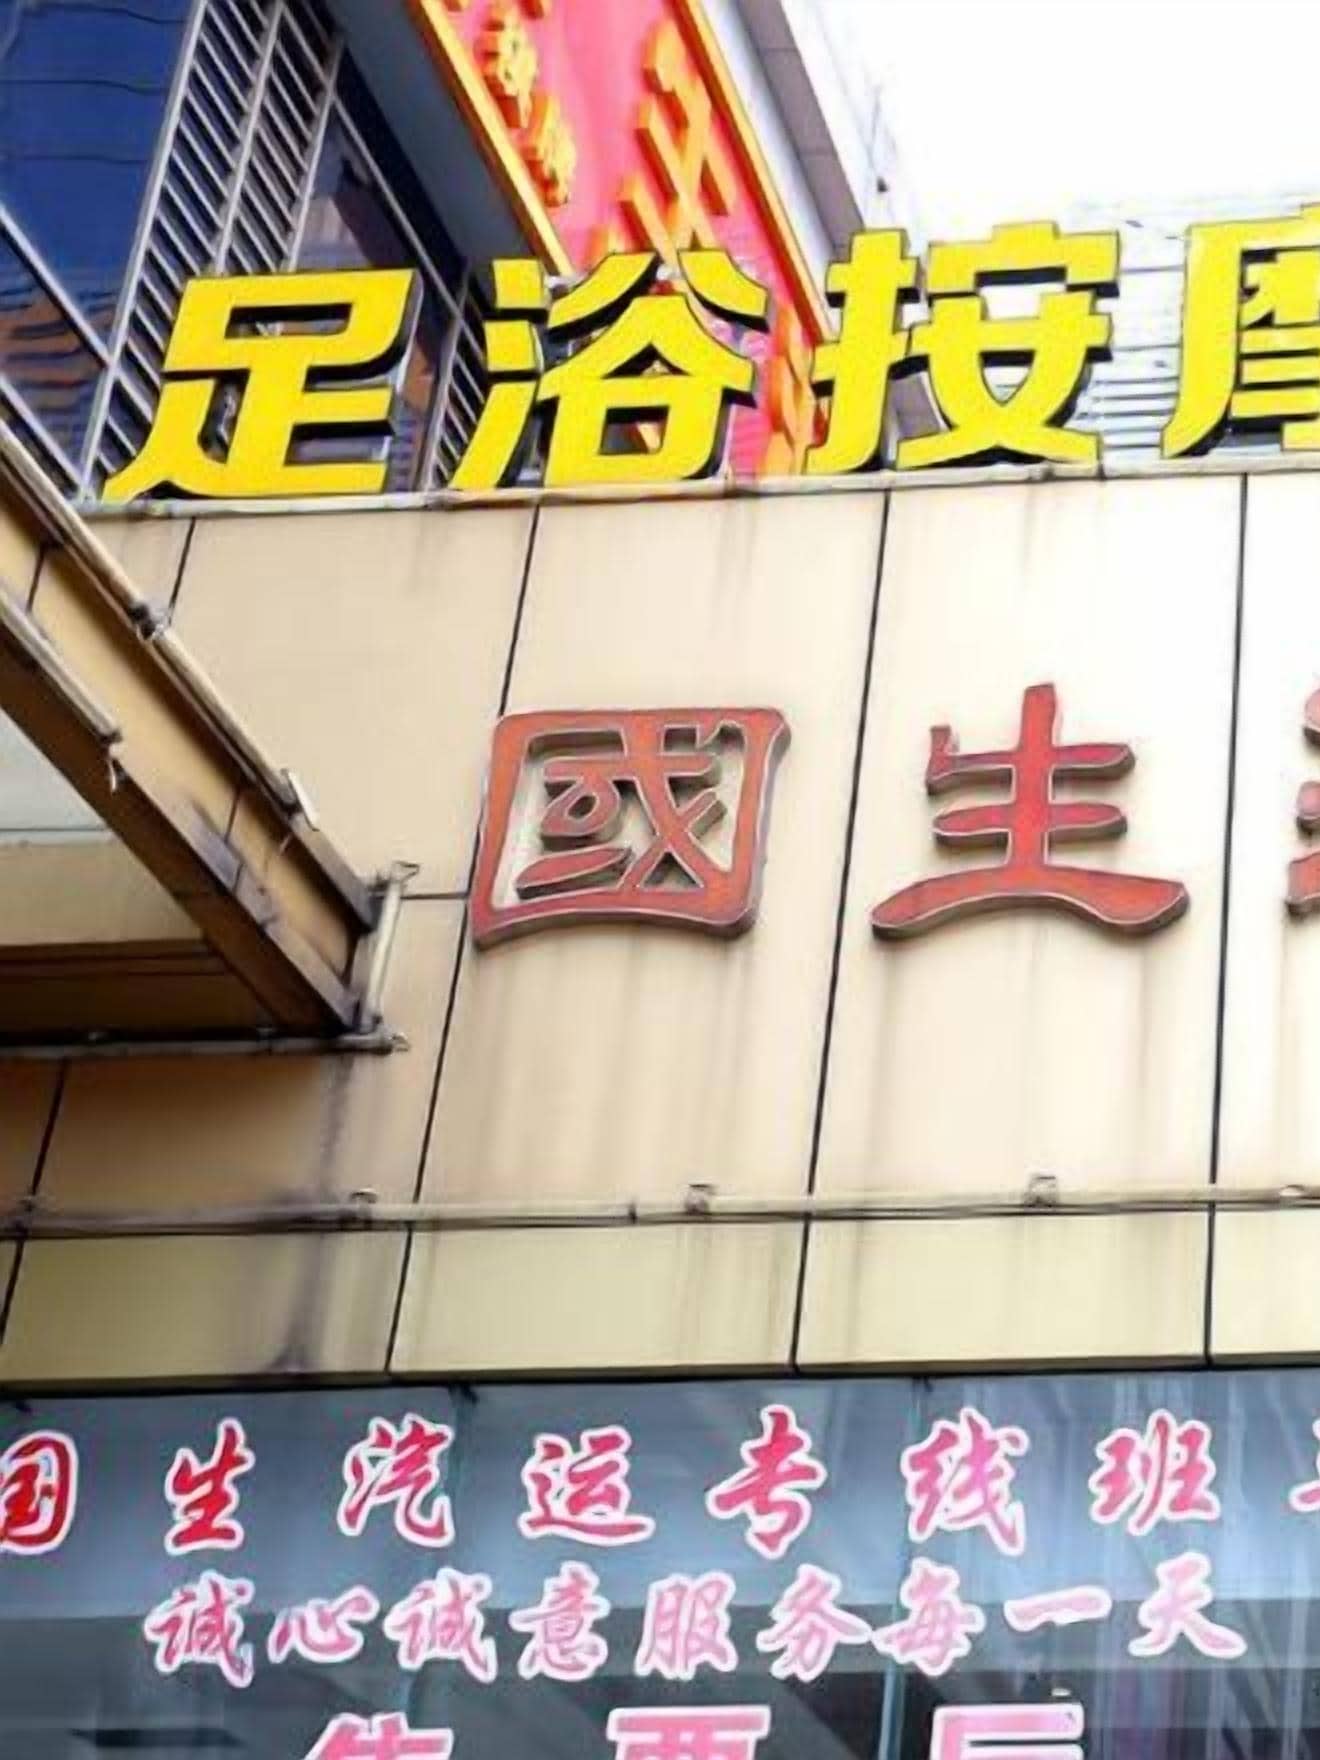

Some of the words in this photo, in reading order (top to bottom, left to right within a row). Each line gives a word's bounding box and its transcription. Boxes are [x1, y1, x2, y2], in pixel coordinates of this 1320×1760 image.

[143, 1550, 1248, 1688] 诚心诚意服务每一天
